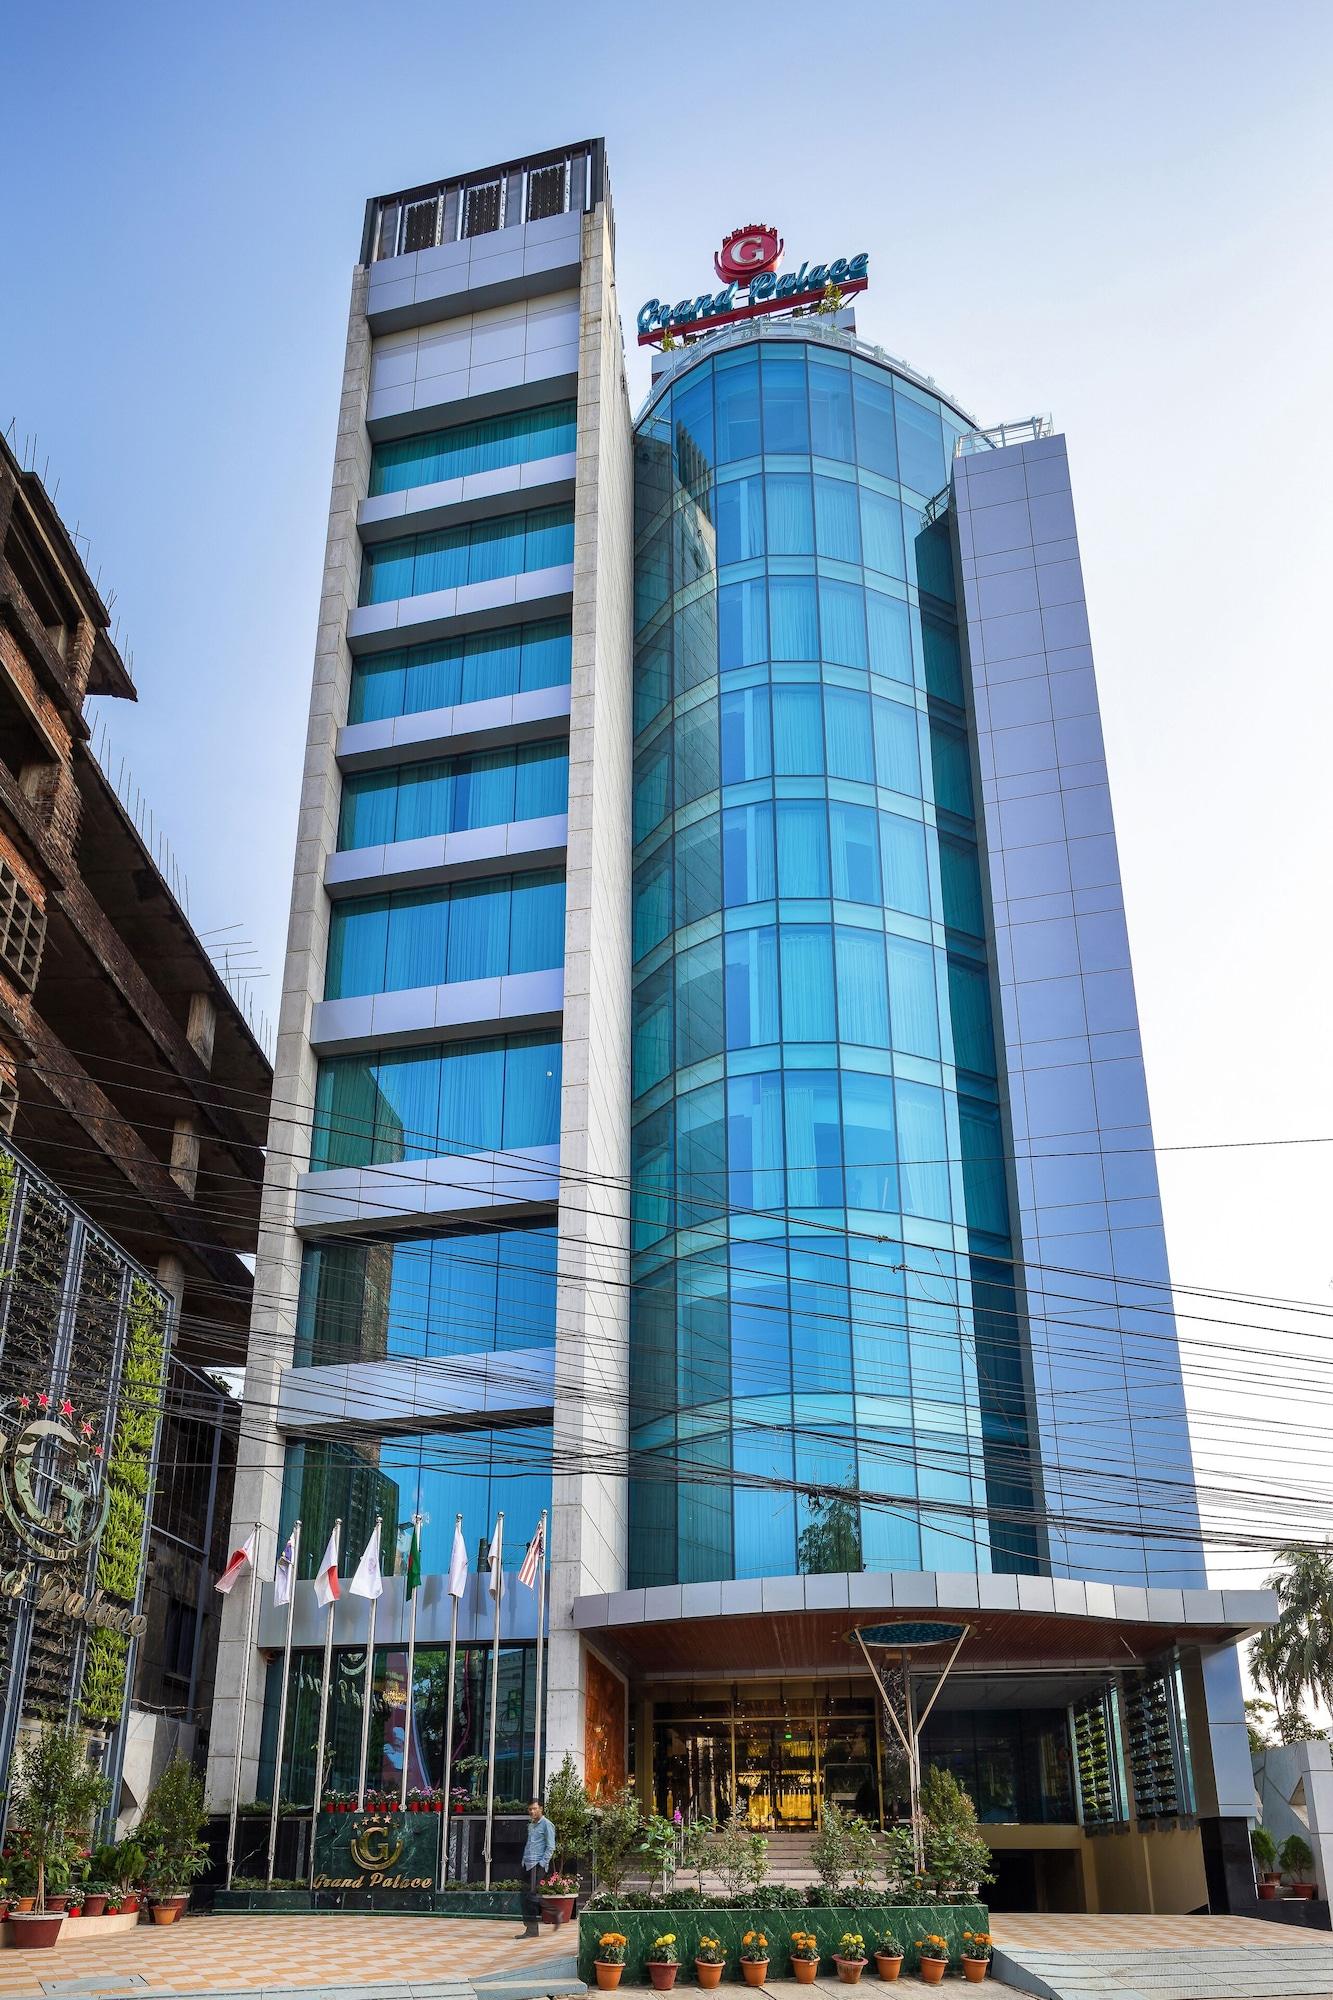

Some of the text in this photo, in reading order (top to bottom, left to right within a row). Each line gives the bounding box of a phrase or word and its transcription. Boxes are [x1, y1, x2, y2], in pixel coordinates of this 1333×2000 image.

[730, 236, 765, 264] G
[637, 253, 869, 332] Grand Palace
[14, 1420, 90, 1542] G
[36, 1572, 148, 1637] Palace
[360, 1827, 389, 1861] G
[313, 1872, 433, 1889] Grand Palace
